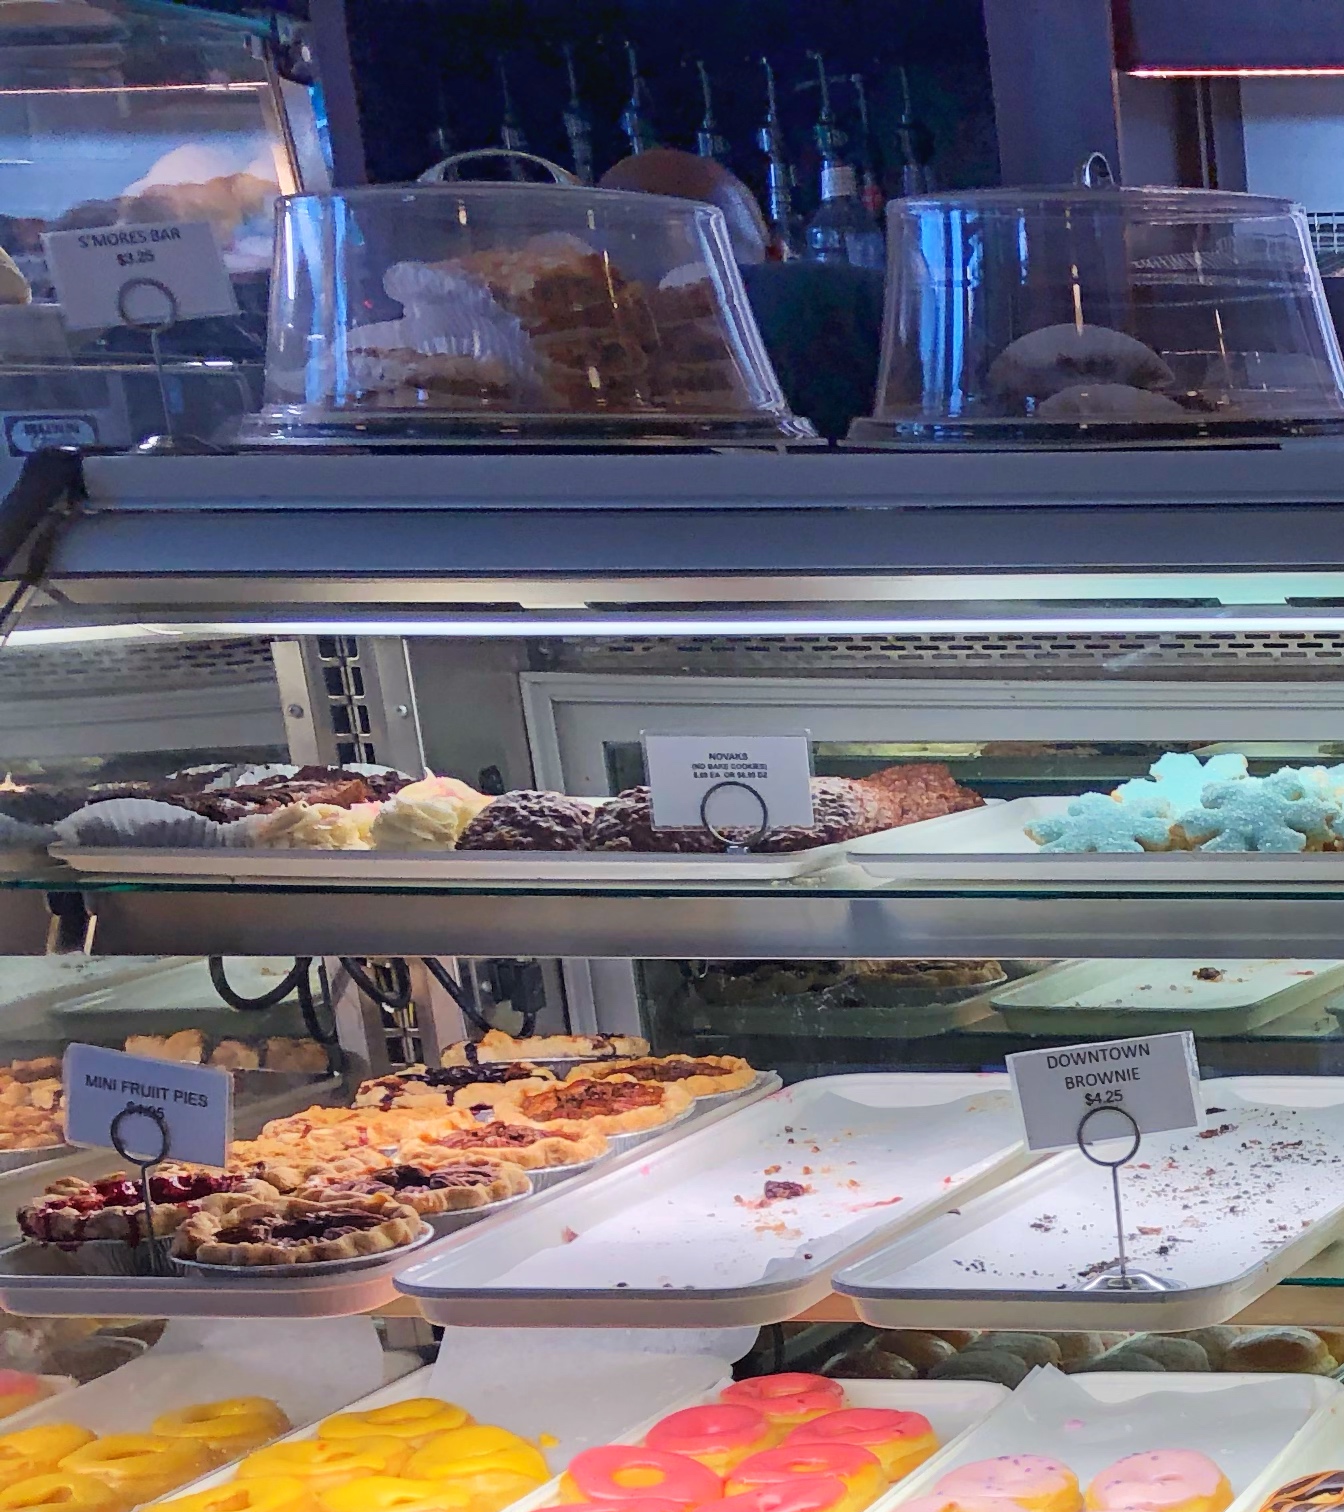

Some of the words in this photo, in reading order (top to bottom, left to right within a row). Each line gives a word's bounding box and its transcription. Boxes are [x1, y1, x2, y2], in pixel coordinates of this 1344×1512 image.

[77, 230, 147, 248] S'MORES
[151, 227, 182, 242] BAR
[1046, 1042, 1150, 1069] DOWNTOWN
[1064, 1066, 1141, 1090] BROWNIE
[85, 1073, 117, 1091] MINI
[121, 1080, 170, 1101] FRUIIT
[173, 1089, 209, 1108] PIES
[1084, 1089, 1124, 1106] $4.25
